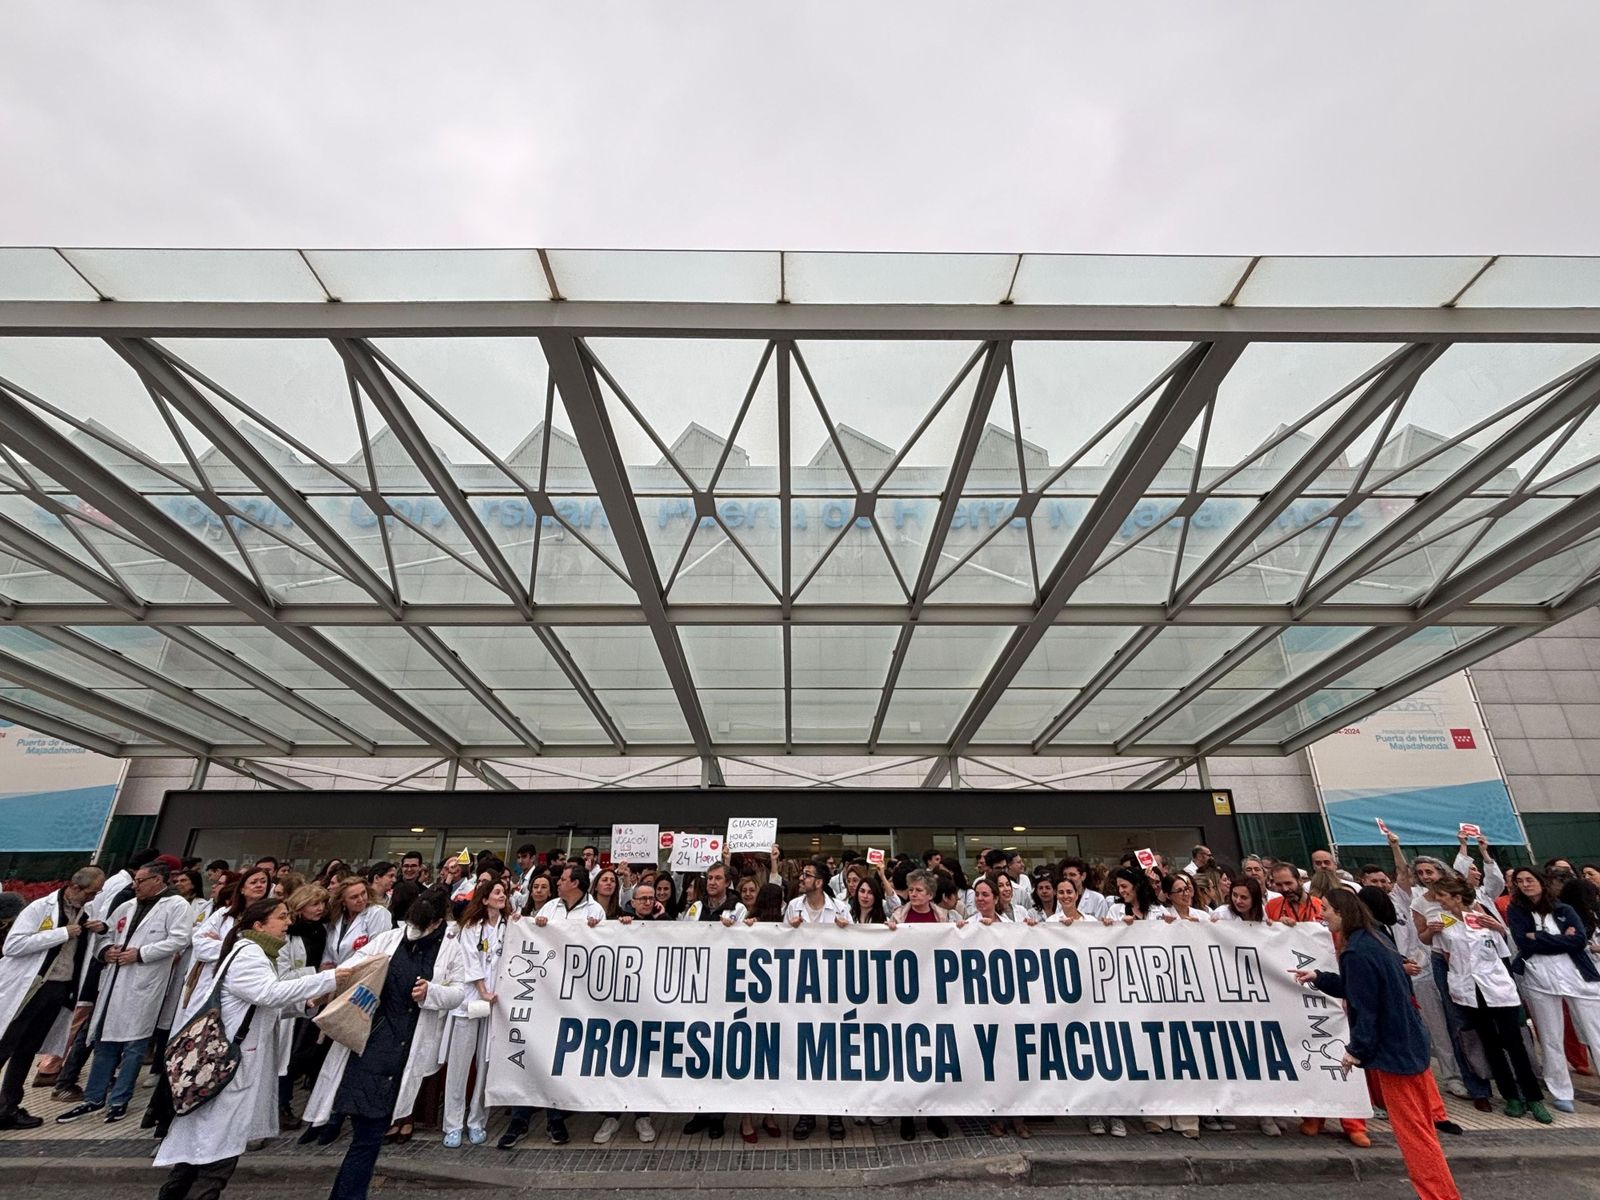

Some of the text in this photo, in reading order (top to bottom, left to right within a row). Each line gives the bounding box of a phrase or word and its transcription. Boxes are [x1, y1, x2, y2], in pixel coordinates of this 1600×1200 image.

[1390, 743, 1448, 751] Majadahonda
[681, 837, 707, 849] STOP
[676, 851, 690, 866] 24
[560, 944, 1270, 1005] POR UN ESTATUTO PROPIO PARA LA
[551, 1006, 1299, 1082] PROFESIÓN MÉDICA Y FACULTATIVA
